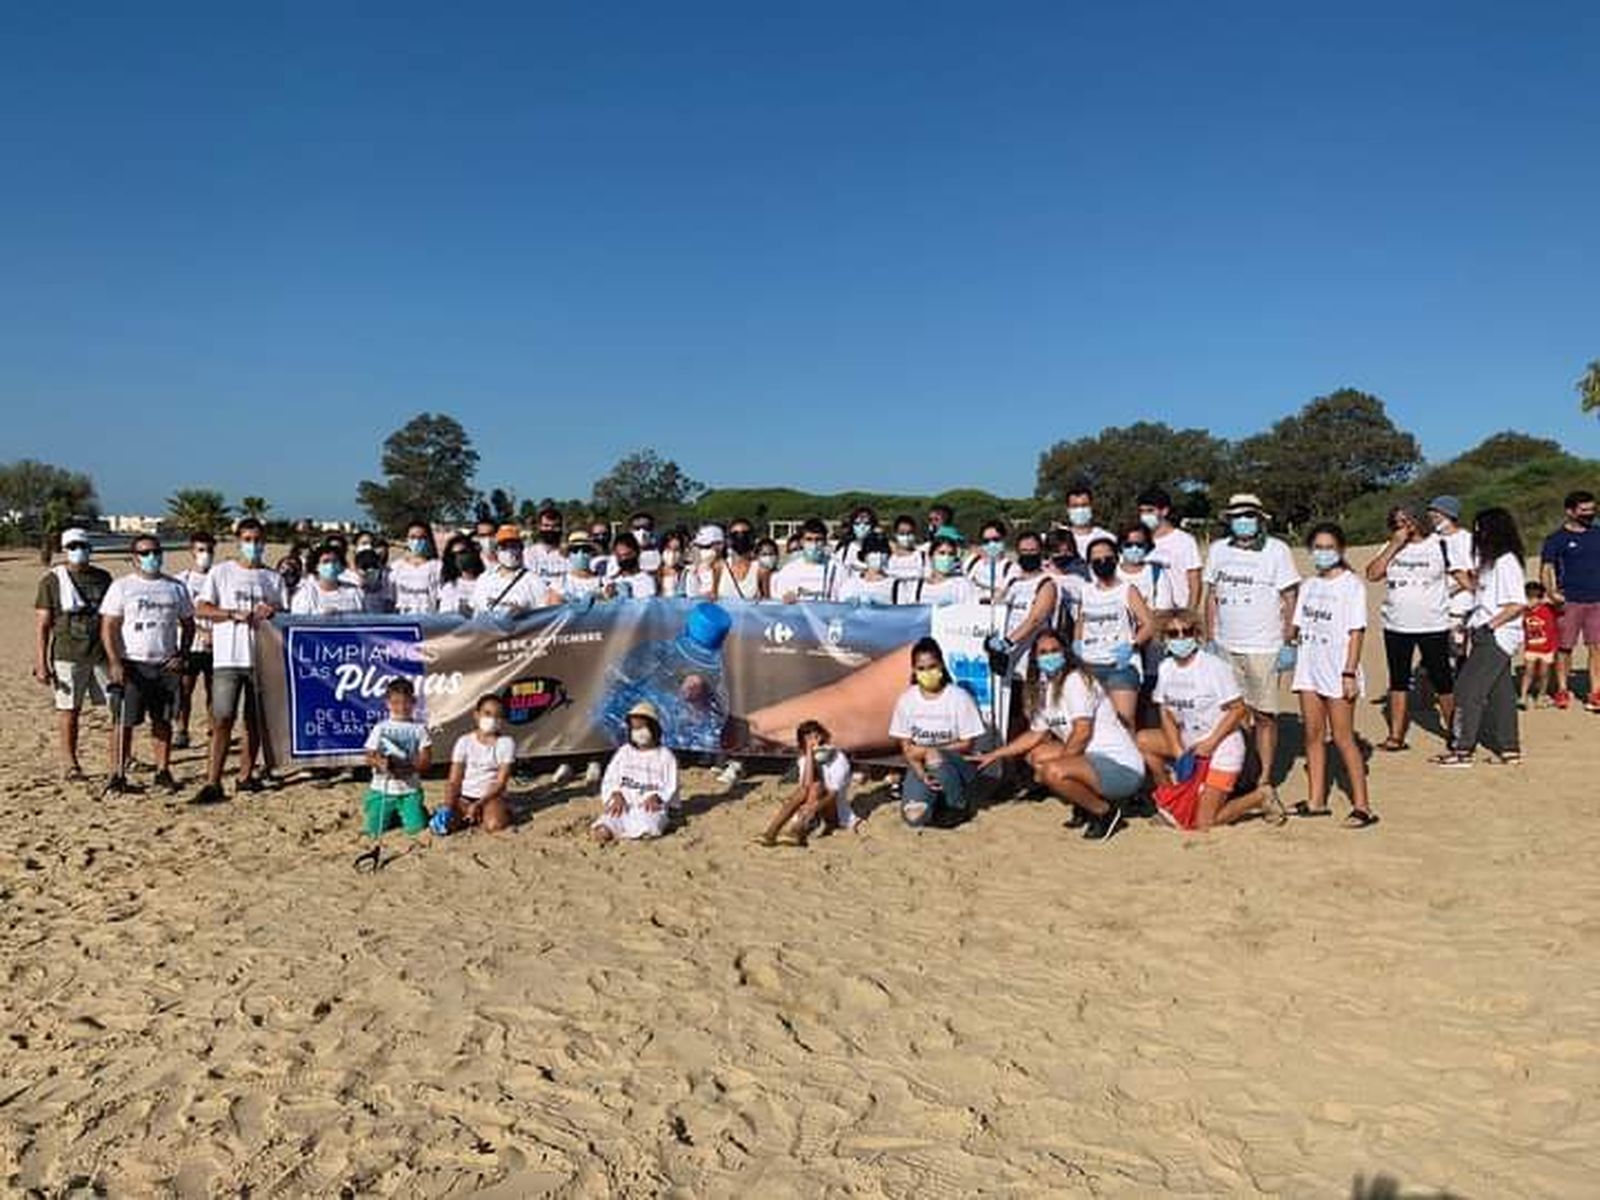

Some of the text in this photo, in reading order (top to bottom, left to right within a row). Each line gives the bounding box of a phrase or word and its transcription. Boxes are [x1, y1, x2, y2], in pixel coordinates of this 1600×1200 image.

[299, 643, 439, 664] LIMPIAMOS
[300, 665, 331, 679] LAS
[315, 708, 335, 723] DE
[341, 707, 362, 722] EL
[305, 721, 376, 737] DE SANT
